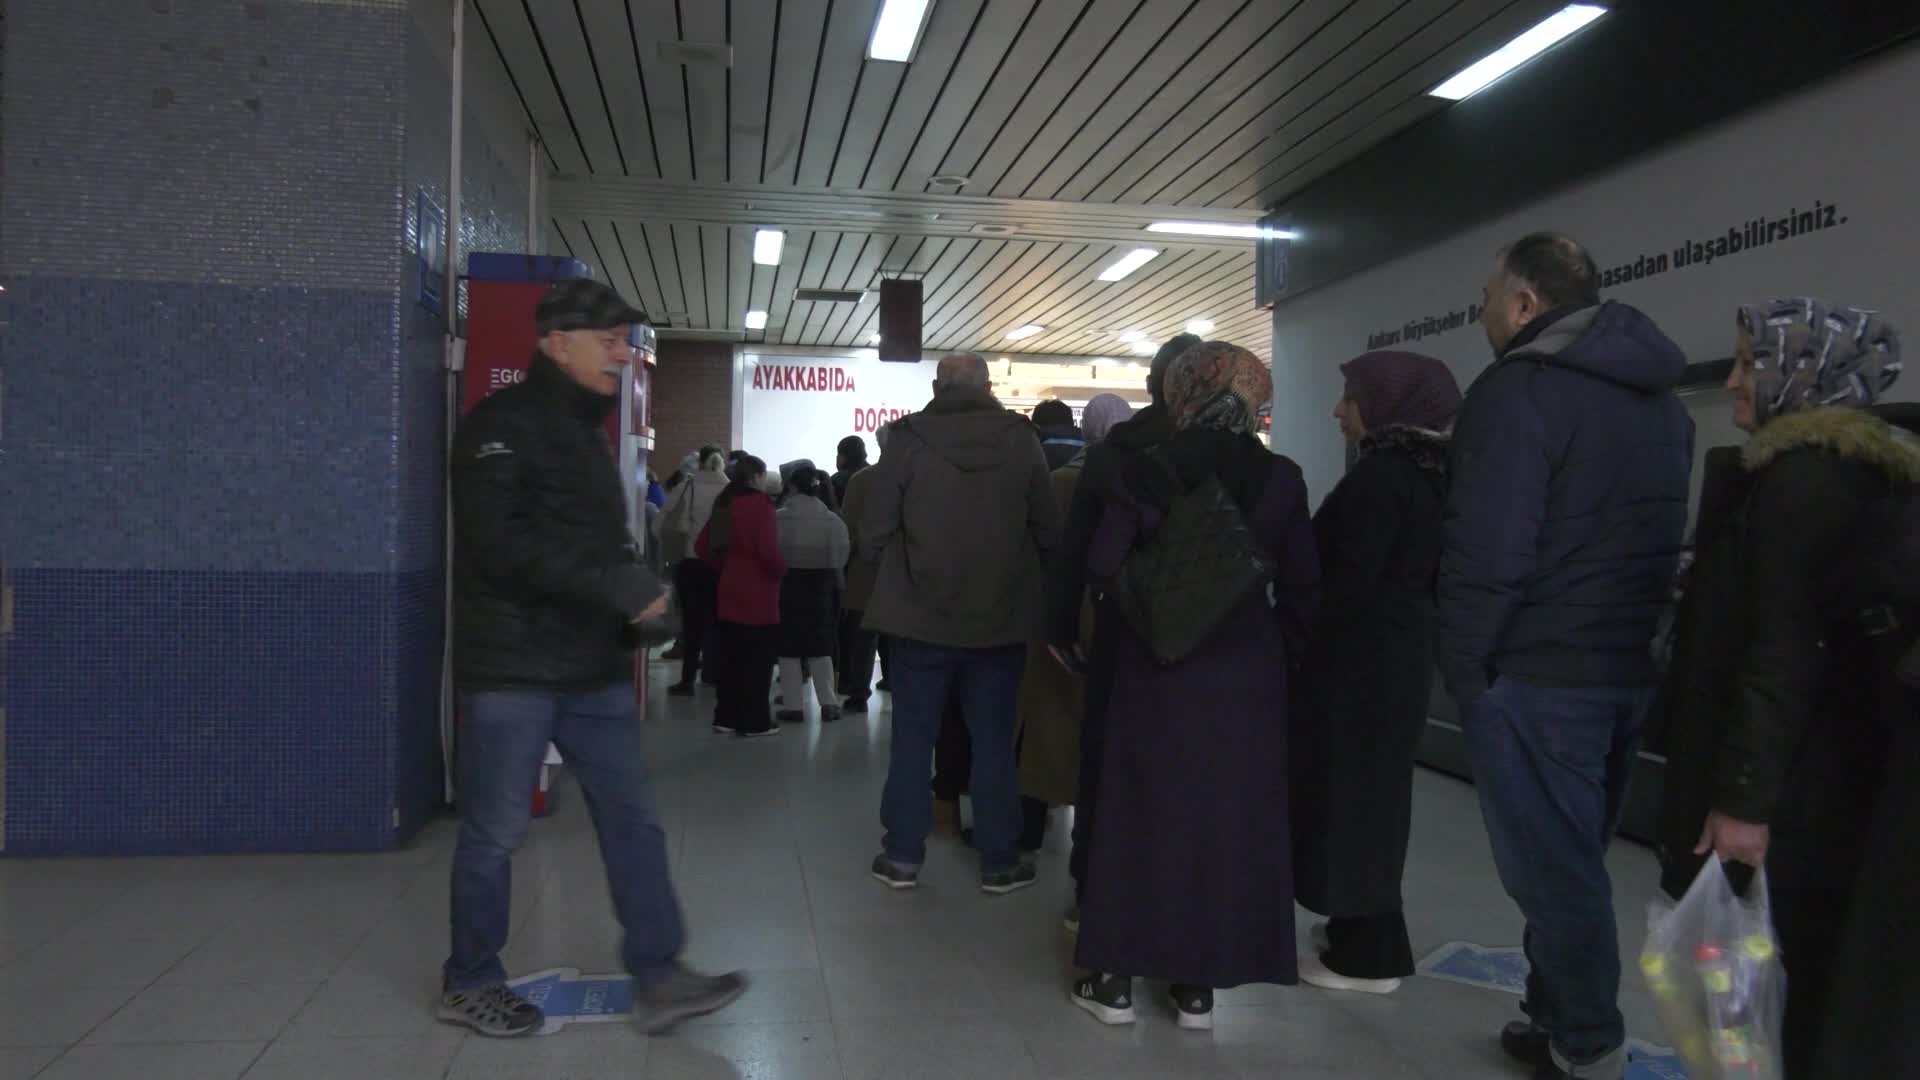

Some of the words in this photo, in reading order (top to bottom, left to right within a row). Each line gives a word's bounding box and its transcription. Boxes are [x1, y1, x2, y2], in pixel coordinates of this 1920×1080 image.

[1673, 200, 1848, 265] ulaşabilirsiniz.
[752, 364, 855, 393] AYAKKABIDA
[854, 400, 911, 433] DOĞR
